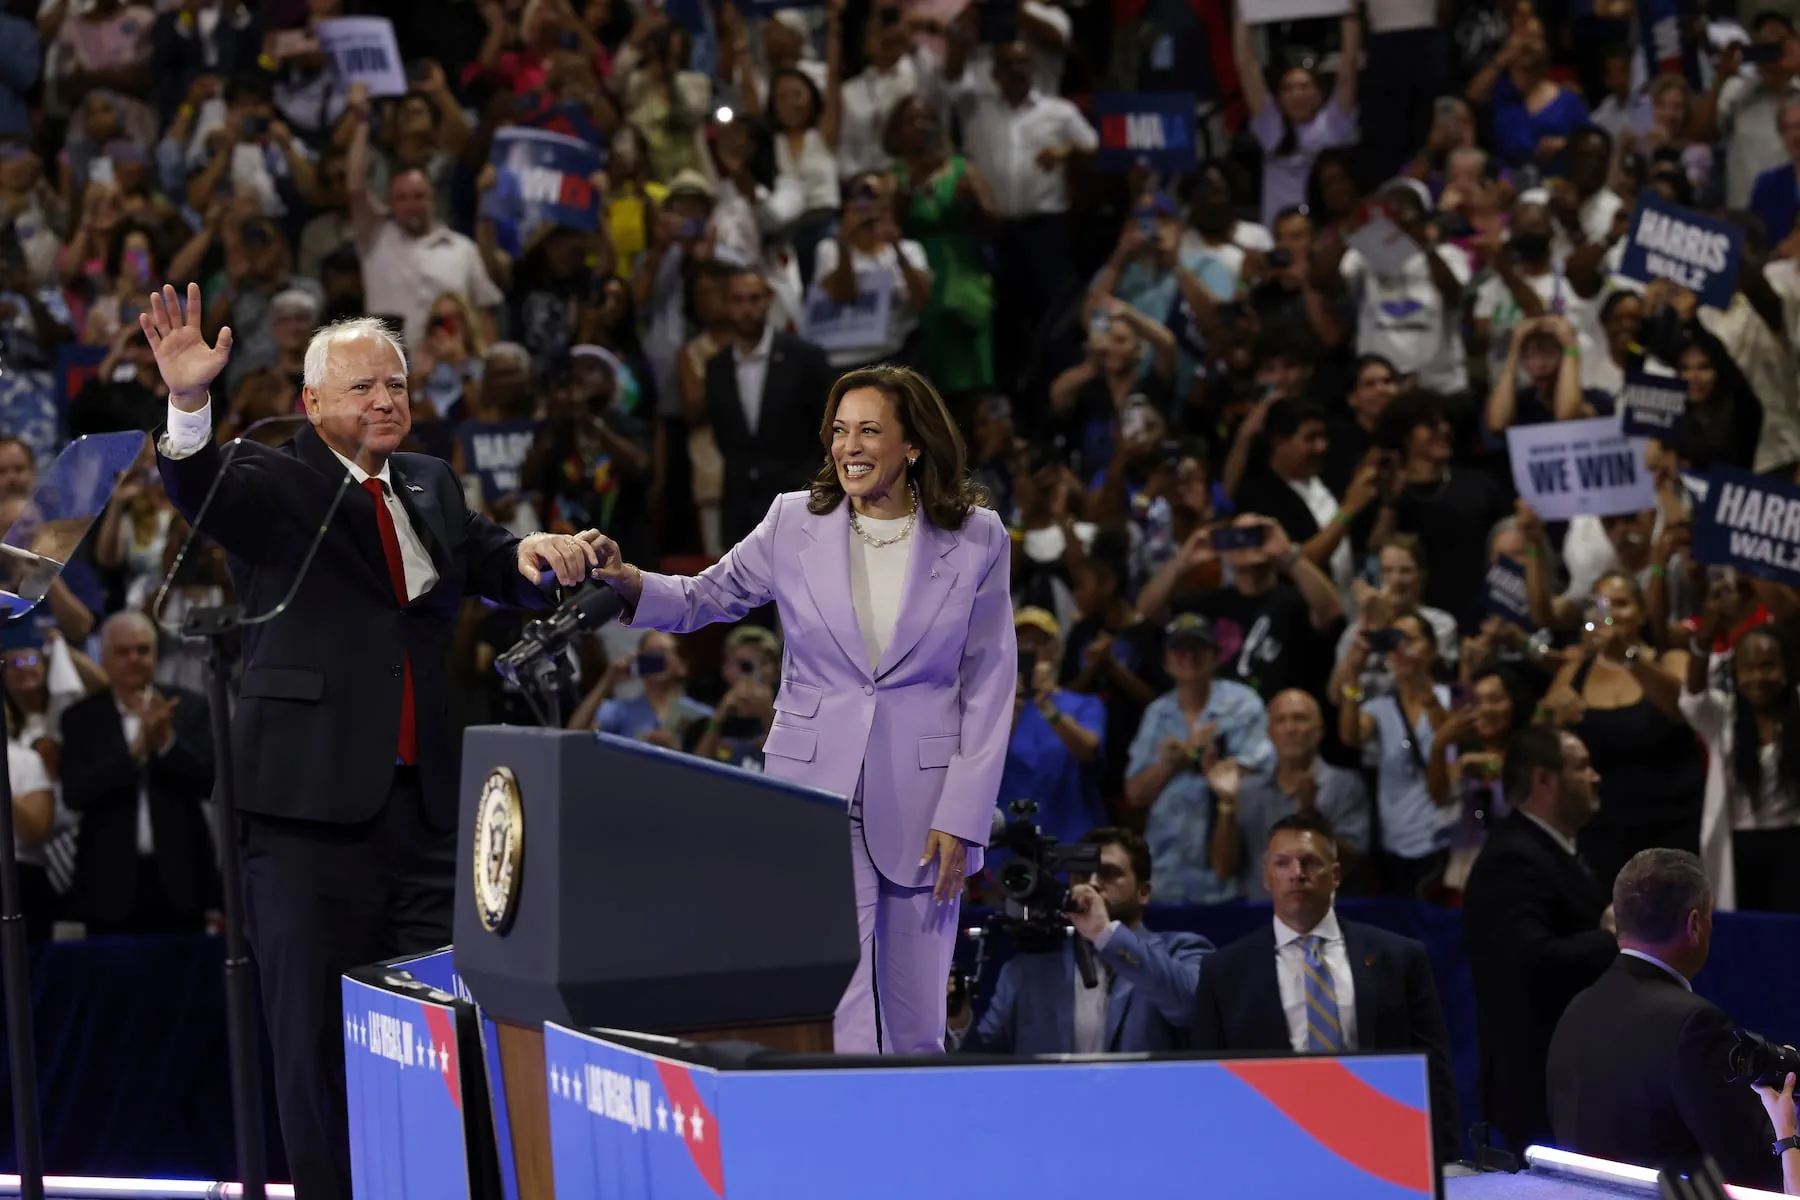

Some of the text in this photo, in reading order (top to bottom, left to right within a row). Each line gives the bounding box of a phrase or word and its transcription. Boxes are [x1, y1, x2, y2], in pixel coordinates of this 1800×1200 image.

[1635, 208, 1730, 274] HARRIS
[1624, 384, 1685, 415] HARRIS
[1528, 451, 1636, 494] WE WIN
[584, 1063, 604, 1116] LAS
